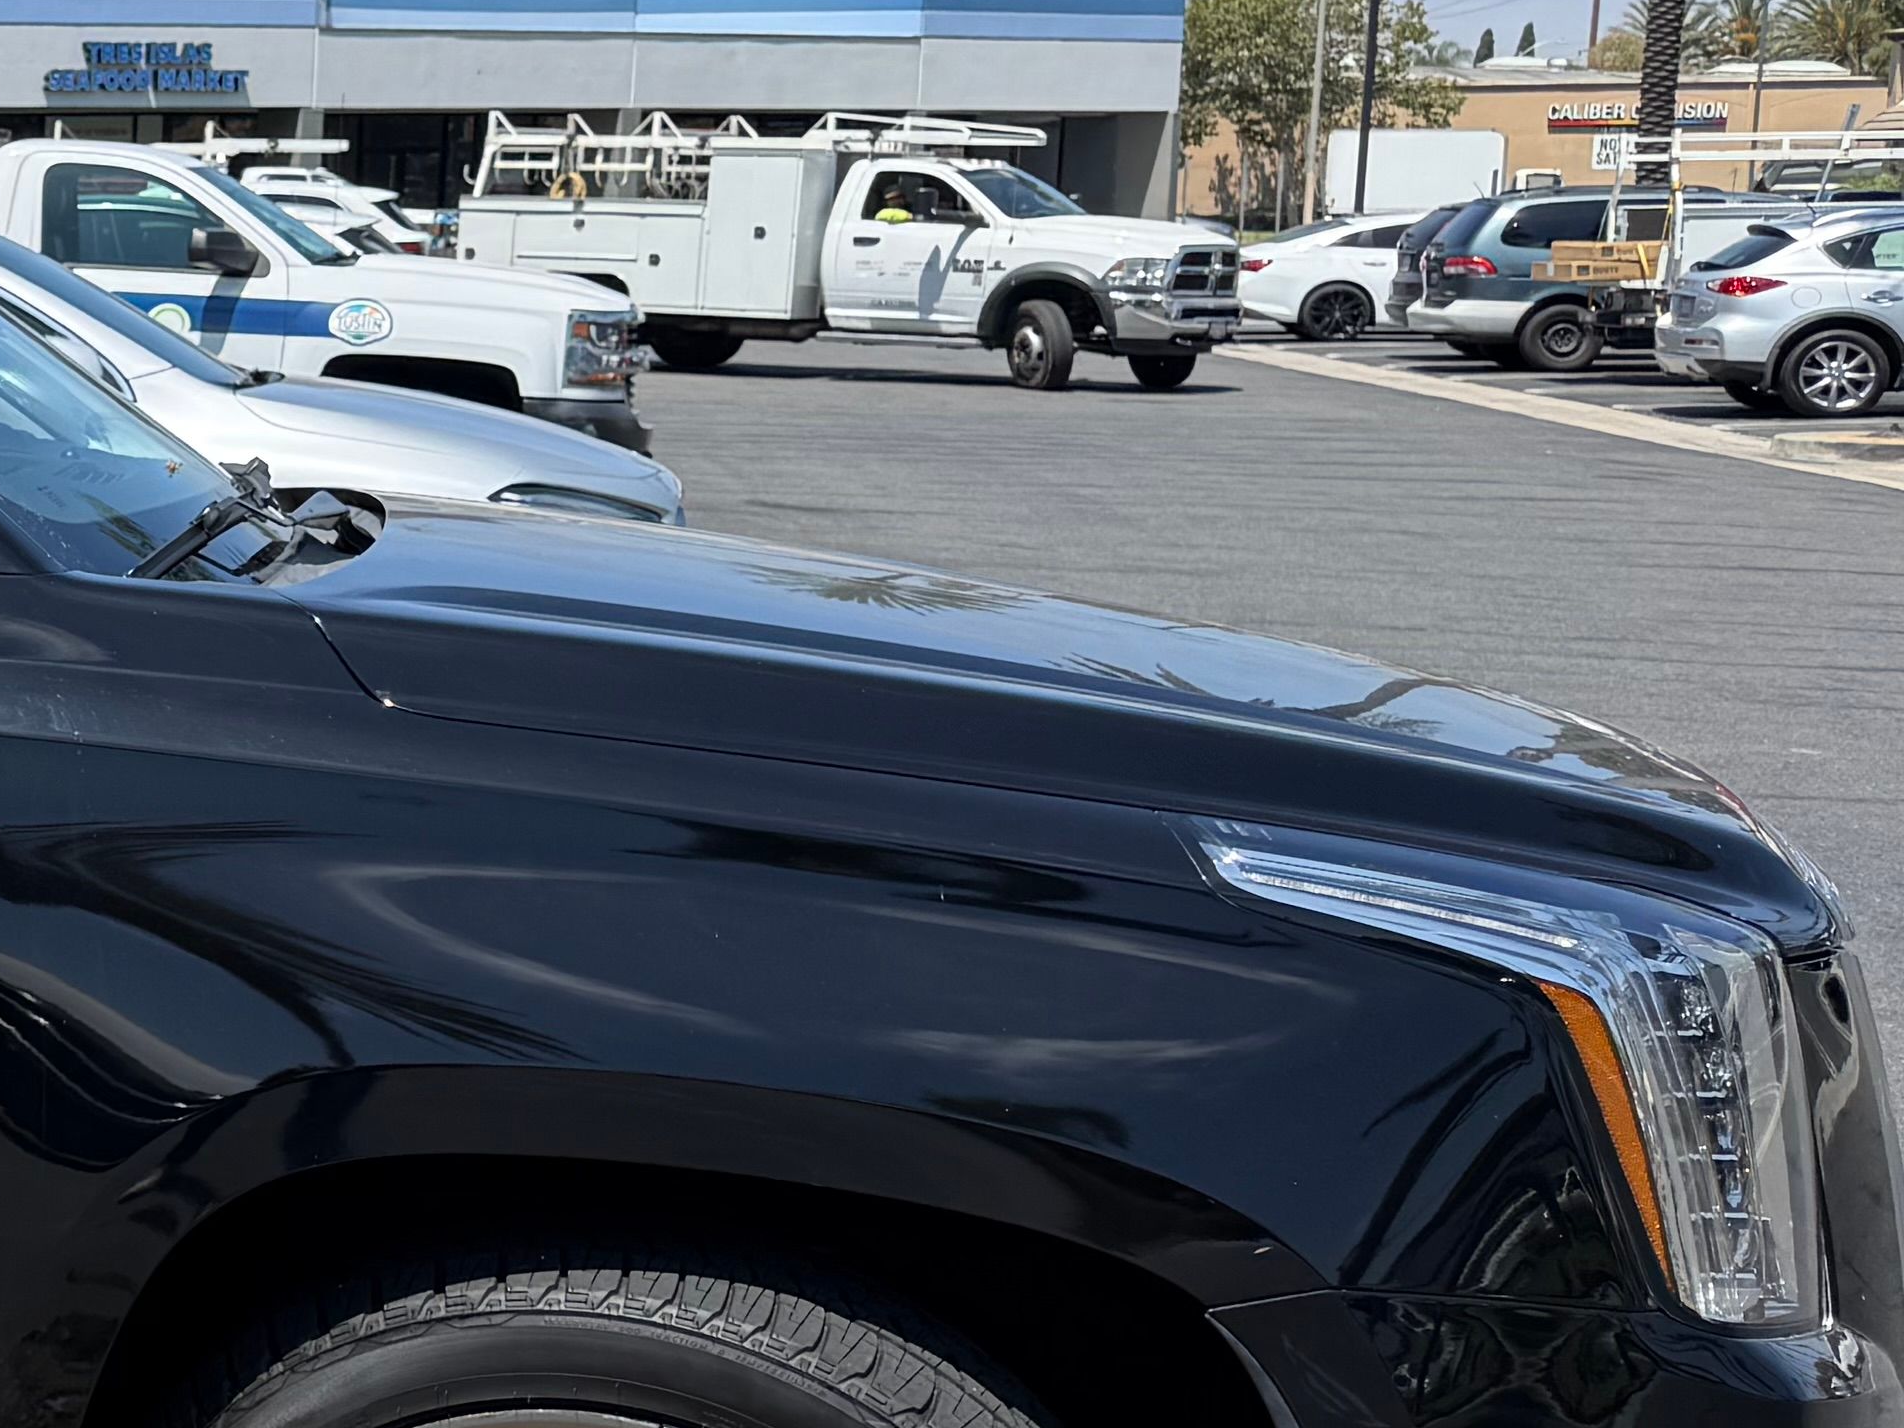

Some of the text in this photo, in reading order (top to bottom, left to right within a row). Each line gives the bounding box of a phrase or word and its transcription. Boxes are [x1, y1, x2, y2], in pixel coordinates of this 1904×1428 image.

[85, 41, 213, 65] TRES ISLAS
[157, 68, 248, 92] MARKET
[1547, 103, 1626, 121] CALIBER
